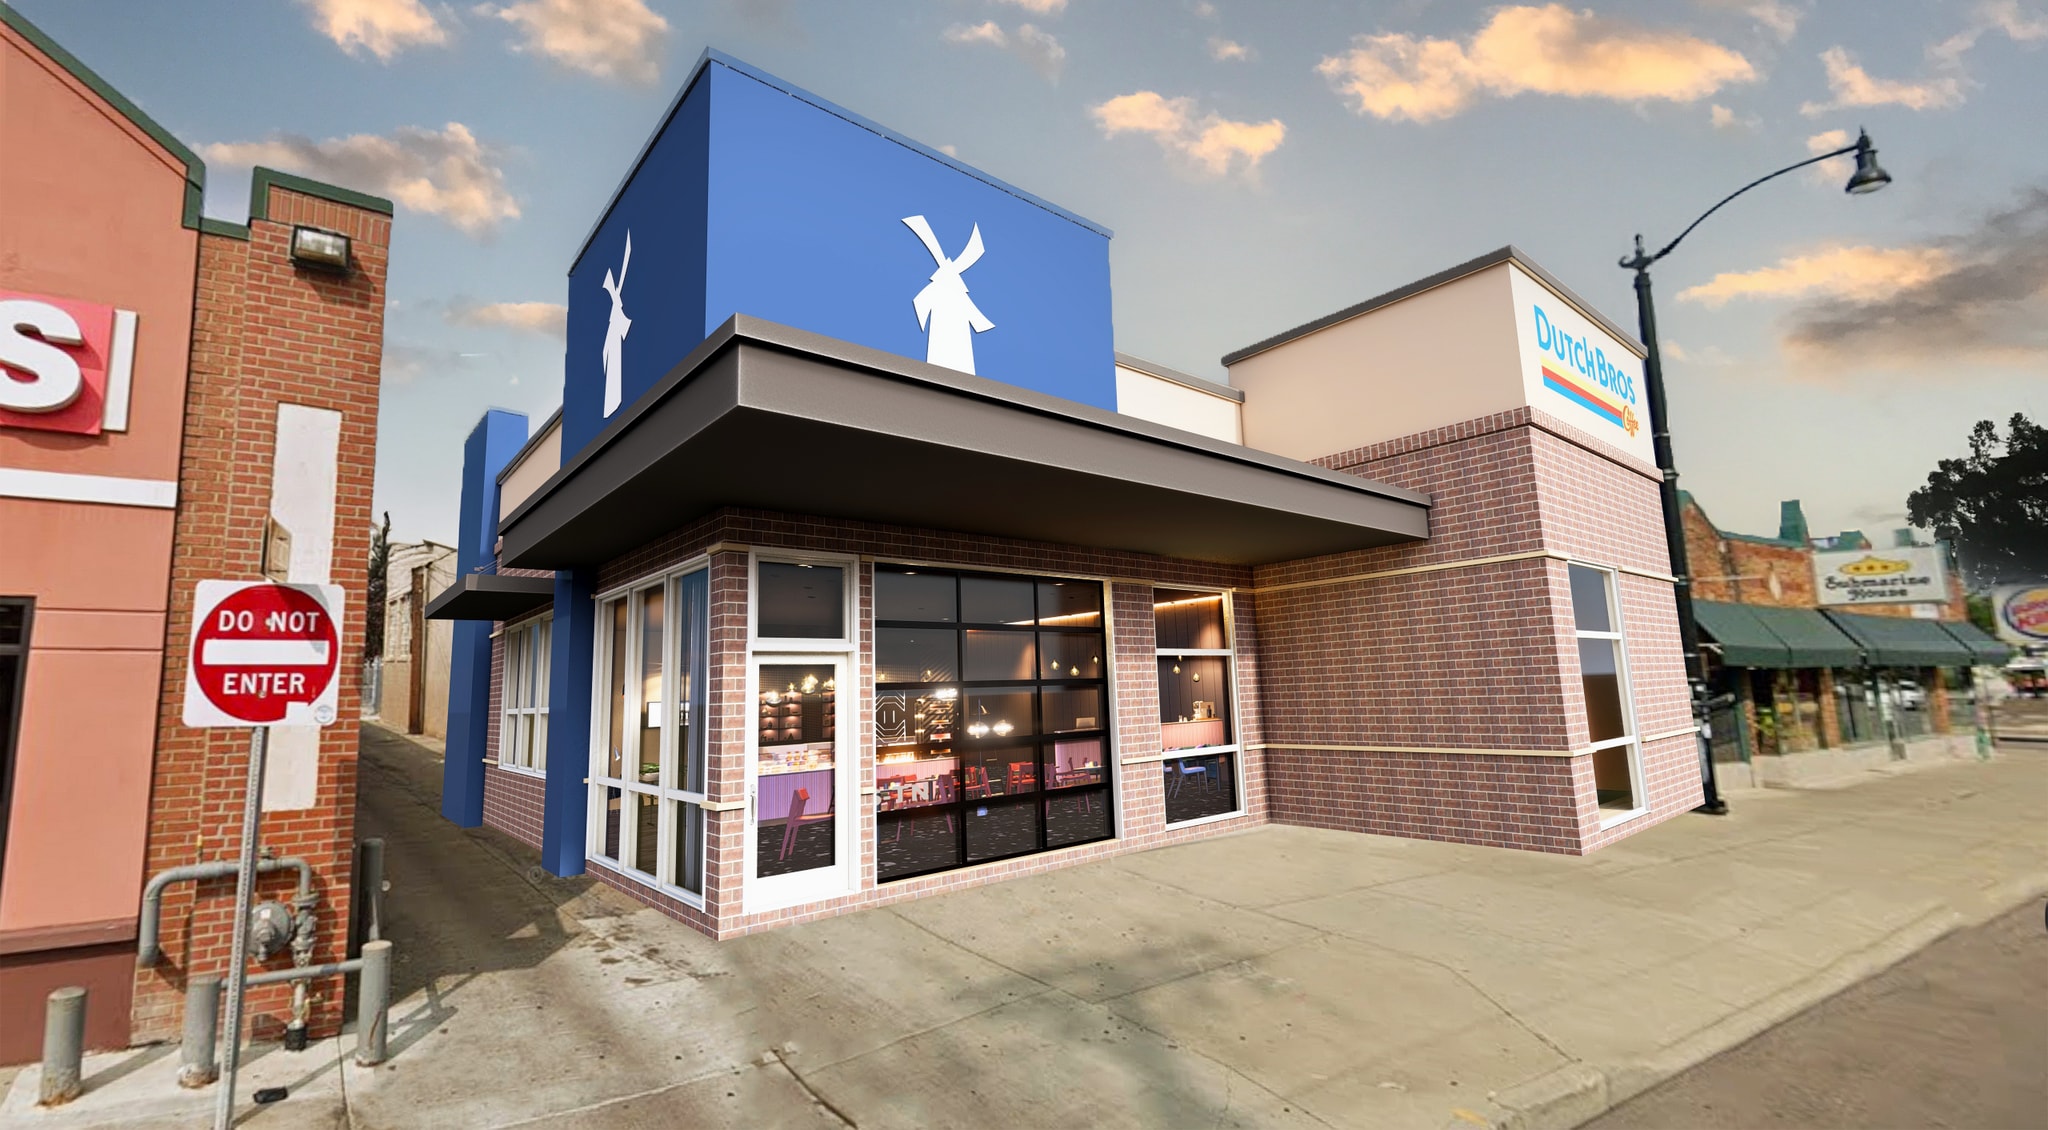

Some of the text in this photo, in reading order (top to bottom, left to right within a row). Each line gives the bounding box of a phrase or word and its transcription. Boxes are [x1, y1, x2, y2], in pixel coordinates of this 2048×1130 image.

[218, 610, 320, 633] DO NOT
[222, 673, 306, 695] ENTER
